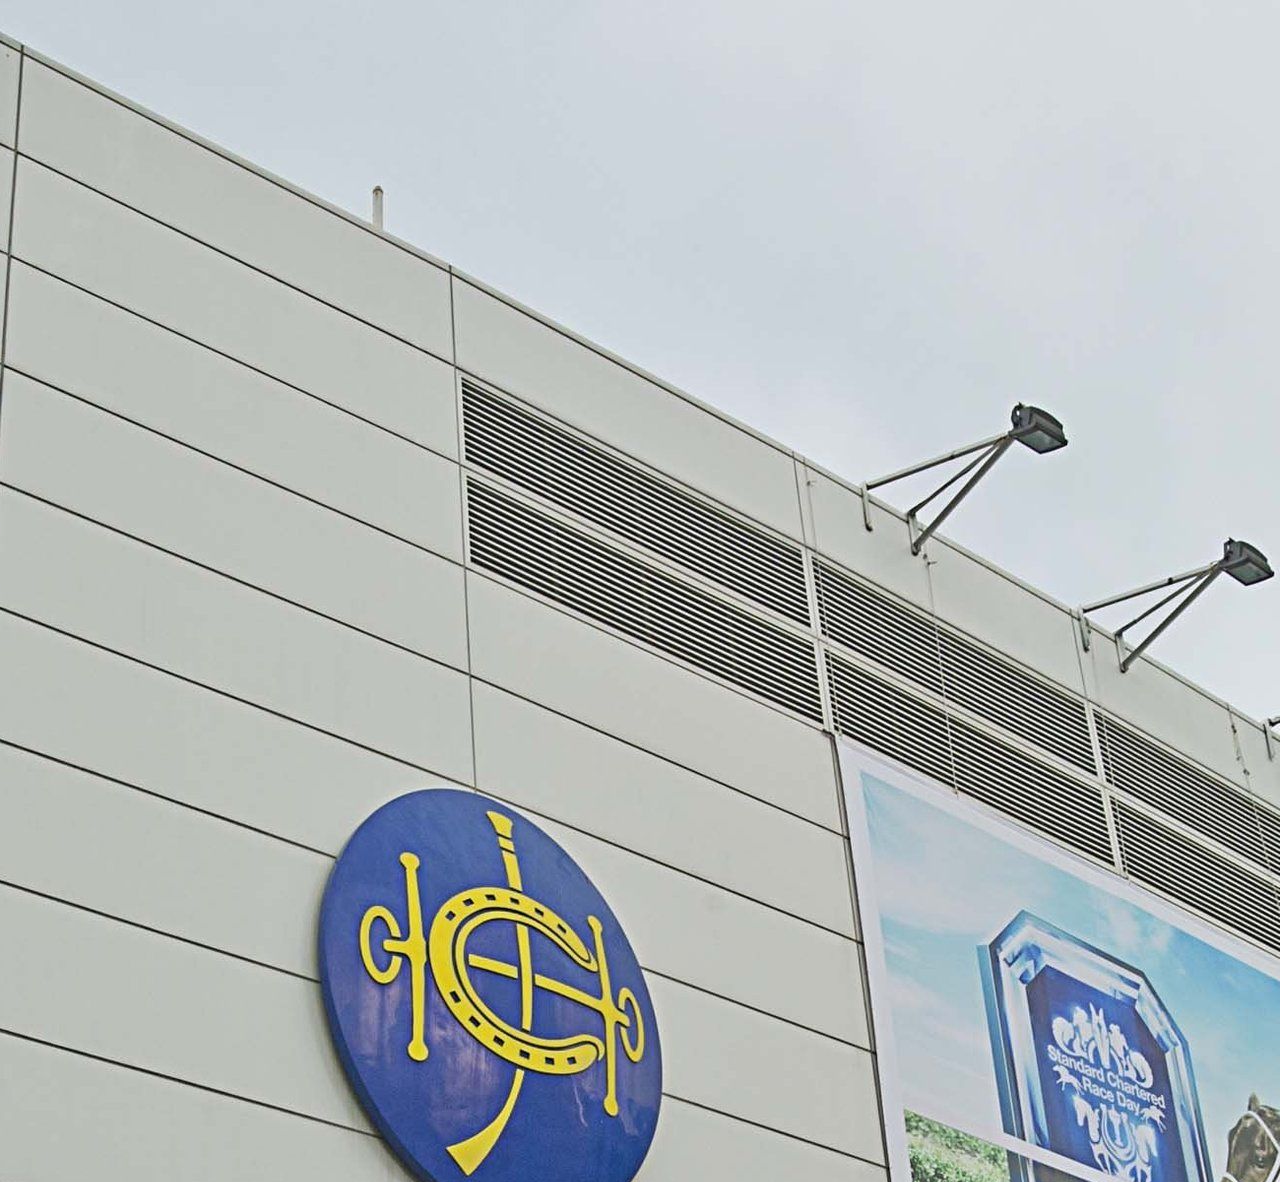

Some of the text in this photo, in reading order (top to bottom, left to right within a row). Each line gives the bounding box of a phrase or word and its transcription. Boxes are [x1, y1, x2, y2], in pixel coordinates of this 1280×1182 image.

[1047, 1044, 1166, 1109] Standard Chartered
[1082, 1076, 1140, 1116] Race Day
